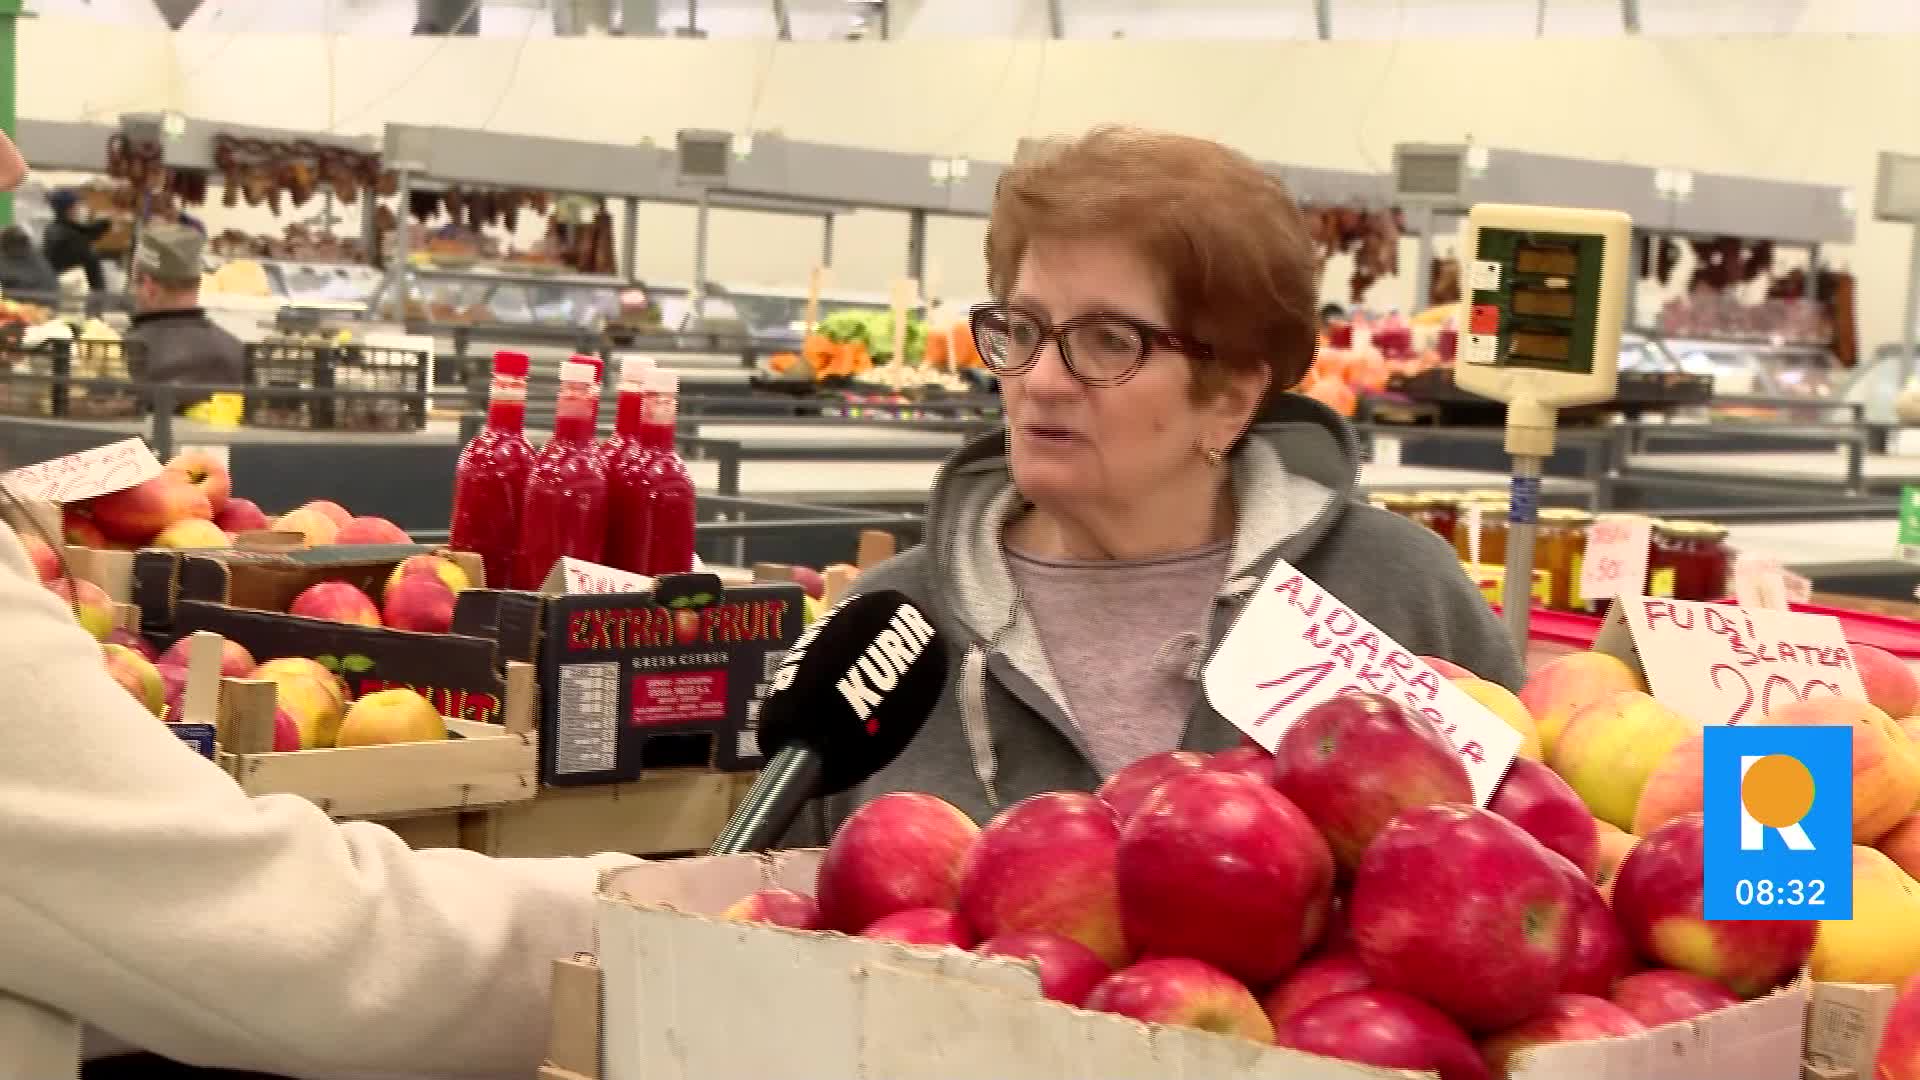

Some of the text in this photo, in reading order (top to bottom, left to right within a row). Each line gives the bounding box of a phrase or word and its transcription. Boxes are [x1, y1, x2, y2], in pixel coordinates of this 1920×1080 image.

[567, 600, 789, 651] EXTRA FRUIT
[1274, 575, 1439, 701] AJDARA
[632, 651, 729, 668] GREEK CITRUS
[835, 603, 937, 721] KURIR
[647, 687, 673, 697] EXTRA
[673, 685, 696, 696] FRUIT
